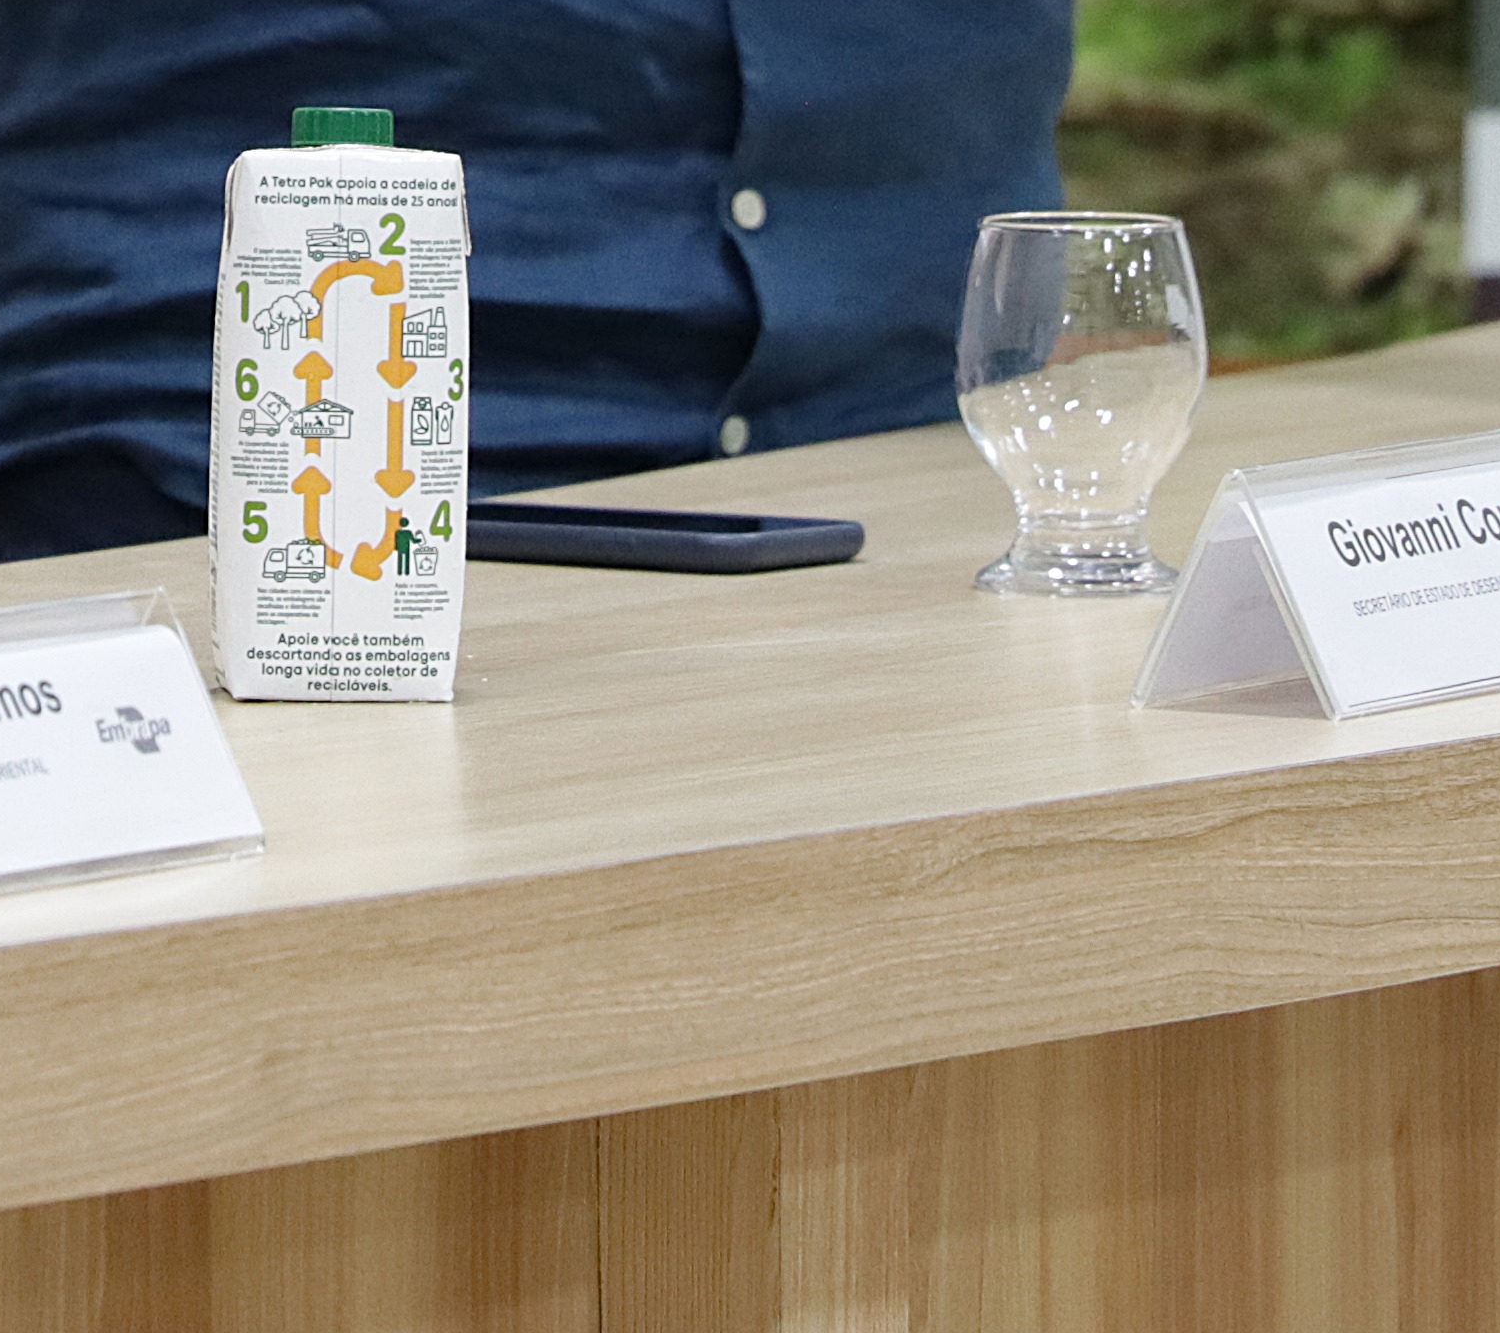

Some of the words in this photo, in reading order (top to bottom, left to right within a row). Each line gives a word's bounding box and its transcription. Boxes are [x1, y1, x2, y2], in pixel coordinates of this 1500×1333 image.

[254, 192, 331, 209] reciclagem
[333, 192, 352, 205] há
[357, 193, 388, 206] mais
[391, 194, 408, 206] de
[411, 195, 424, 207] 25
[260, 176, 269, 187] A
[271, 176, 306, 189] Tetra
[309, 176, 333, 189] Pak
[336, 178, 376, 194] apoia
[380, 181, 389, 190] a
[391, 178, 438, 191] cadeia
[441, 178, 456, 191] de
[379, 213, 406, 255] 2
[235, 280, 249, 323] 1
[235, 359, 259, 402] 6
[448, 359, 464, 402] 3
[242, 501, 268, 544] 5
[429, 500, 453, 543] 4
[1328, 502, 1461, 567] Giovanni
[1353, 592, 1411, 617] SECRETÁRIO
[1411, 589, 1426, 606] DE
[1424, 583, 1460, 603] ESTADO
[1459, 581, 1474, 598] DE
[247, 647, 342, 661] descartando
[346, 652, 361, 661] as
[365, 648, 451, 664] embalagens
[278, 633, 319, 647] Apoie
[323, 633, 359, 646] você
[363, 633, 424, 647] também
[262, 663, 302, 679] longa
[307, 664, 339, 677] vida
[344, 667, 361, 677] no
[365, 664, 416, 677] coletor
[420, 664, 438, 677] de
[307, 679, 392, 692] recicláveis.
